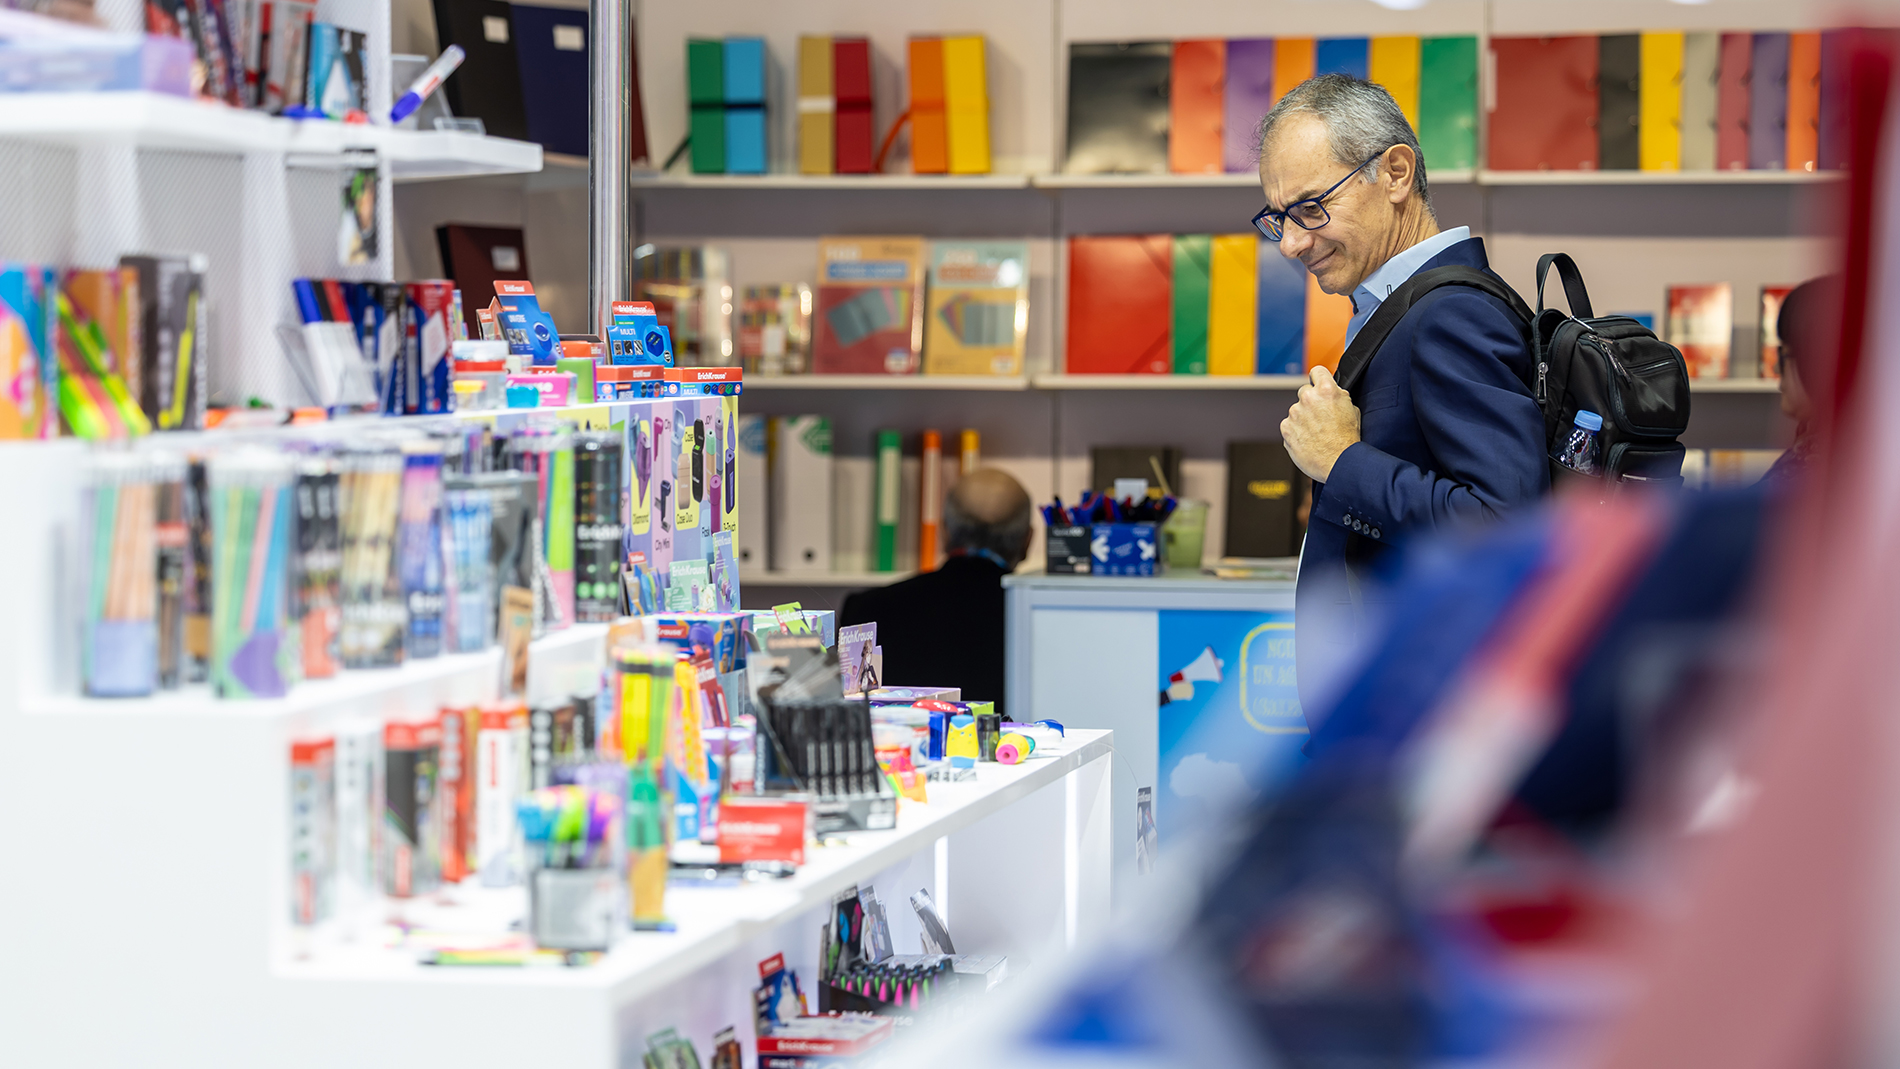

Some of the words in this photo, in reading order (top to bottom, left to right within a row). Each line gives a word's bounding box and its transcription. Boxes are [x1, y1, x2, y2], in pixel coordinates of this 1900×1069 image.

[697, 372, 727, 380] ErichKrause
[672, 565, 706, 577] ErichKrause
[840, 629, 874, 645] ErichKrause
